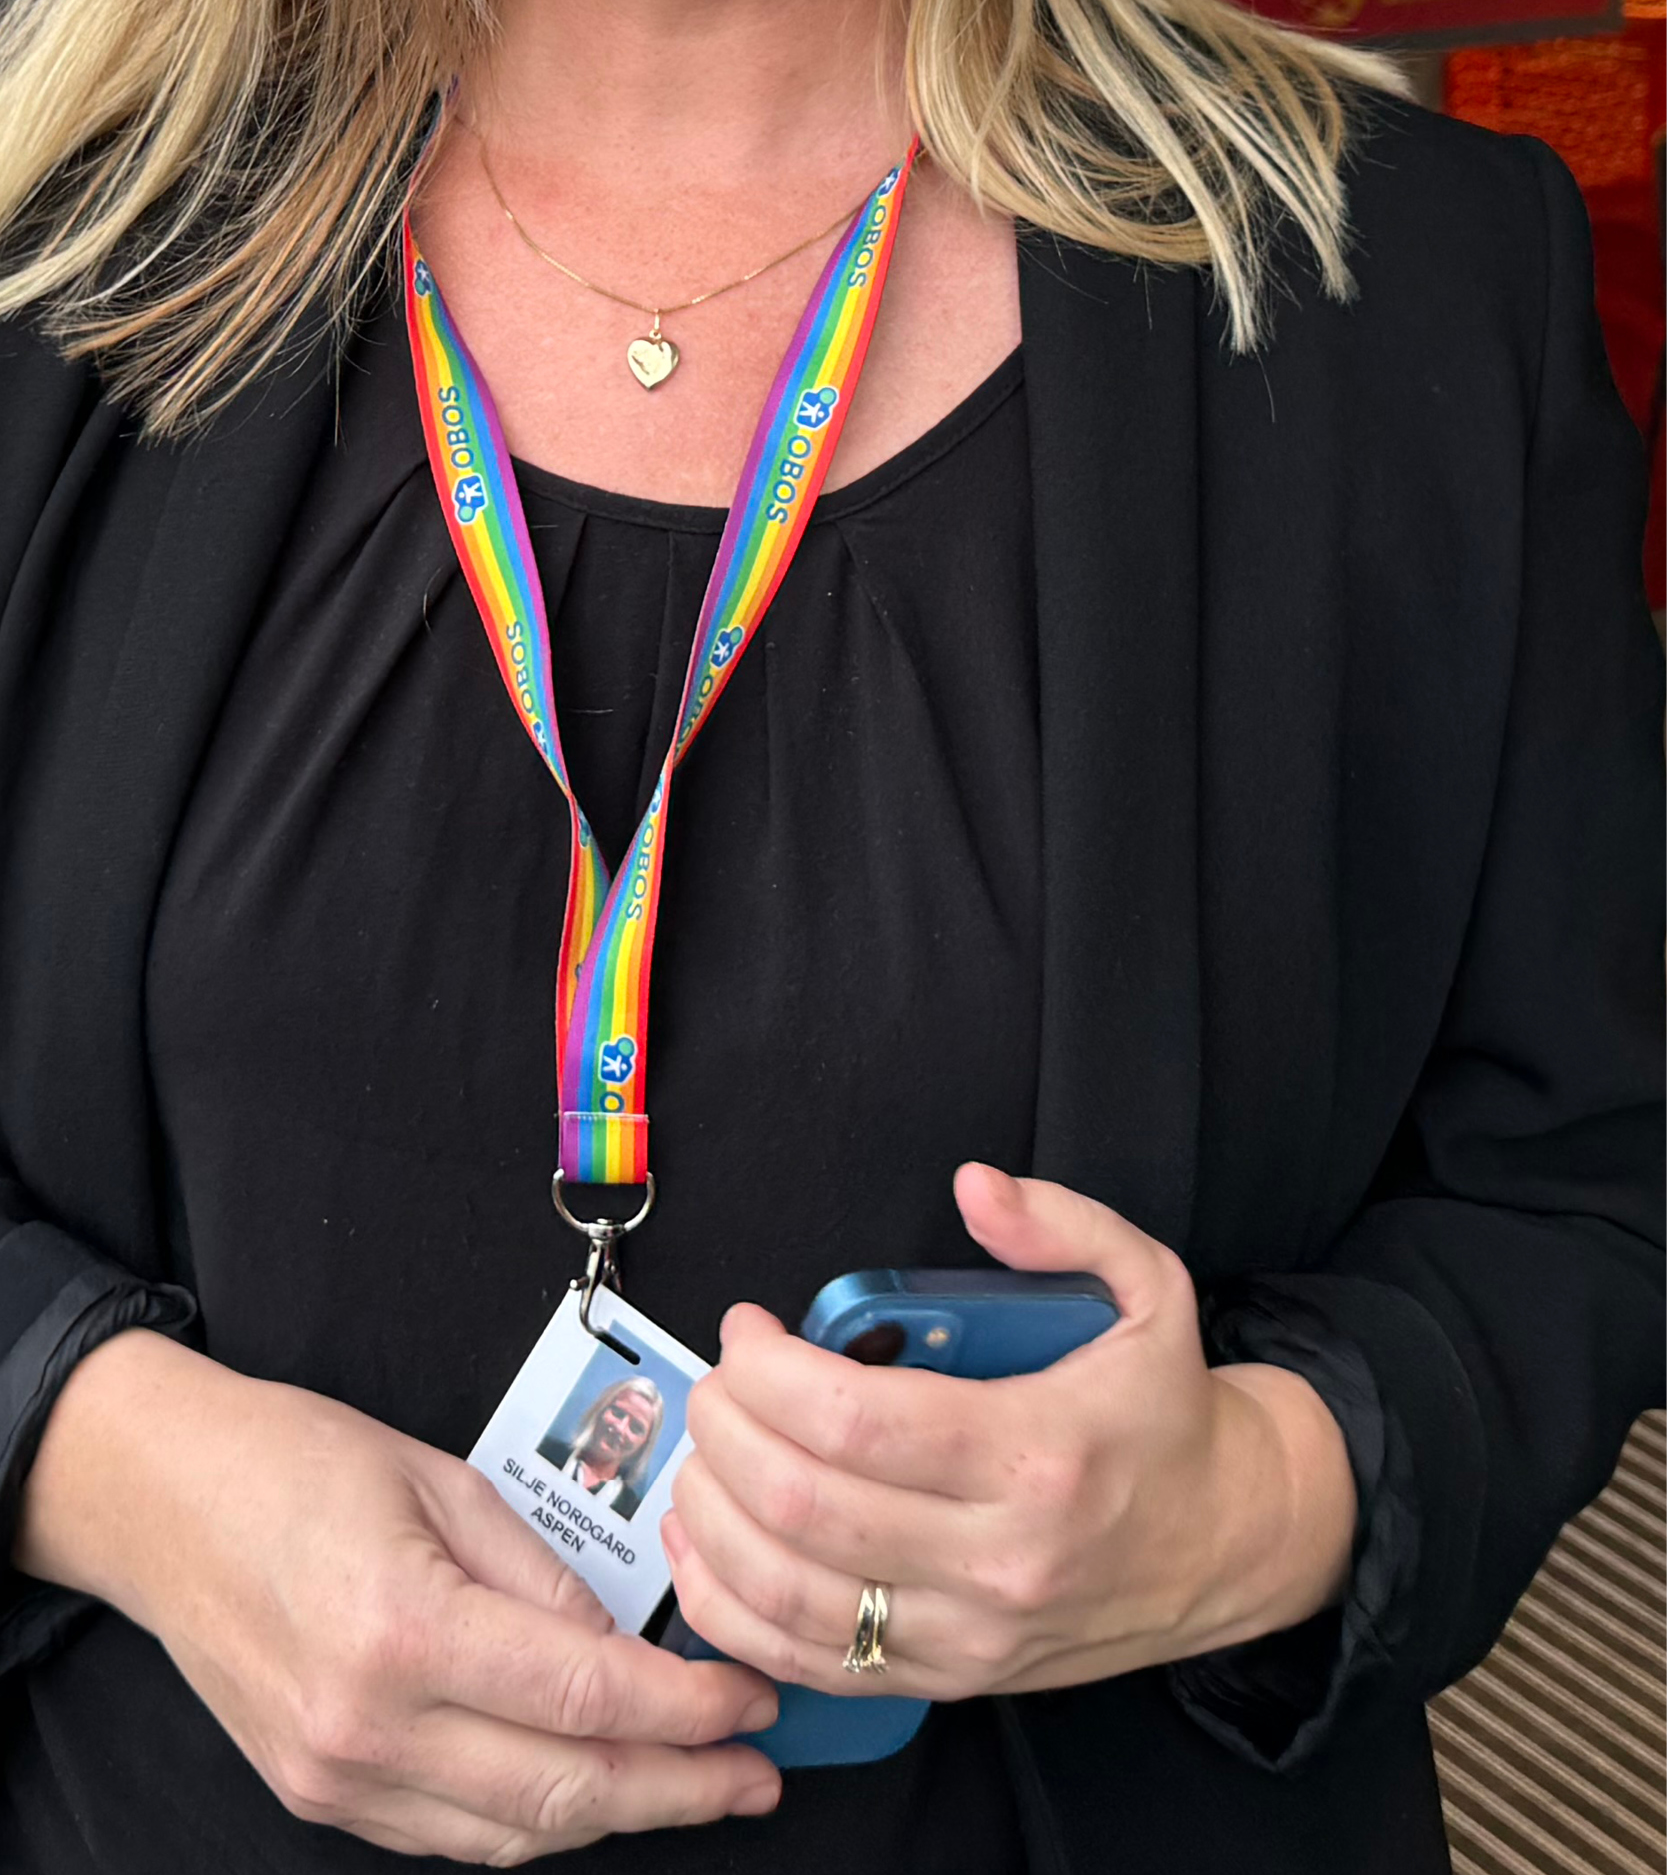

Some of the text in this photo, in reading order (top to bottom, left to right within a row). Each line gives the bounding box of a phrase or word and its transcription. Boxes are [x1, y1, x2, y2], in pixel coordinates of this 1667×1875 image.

[847, 203, 888, 290] OBOS
[438, 385, 475, 469] OBOS
[765, 434, 813, 526] OBOS
[505, 621, 536, 715] OBOS
[625, 823, 656, 921] OBOS
[502, 1457, 548, 1499] SILJE
[530, 1505, 587, 1554] ASPEN
